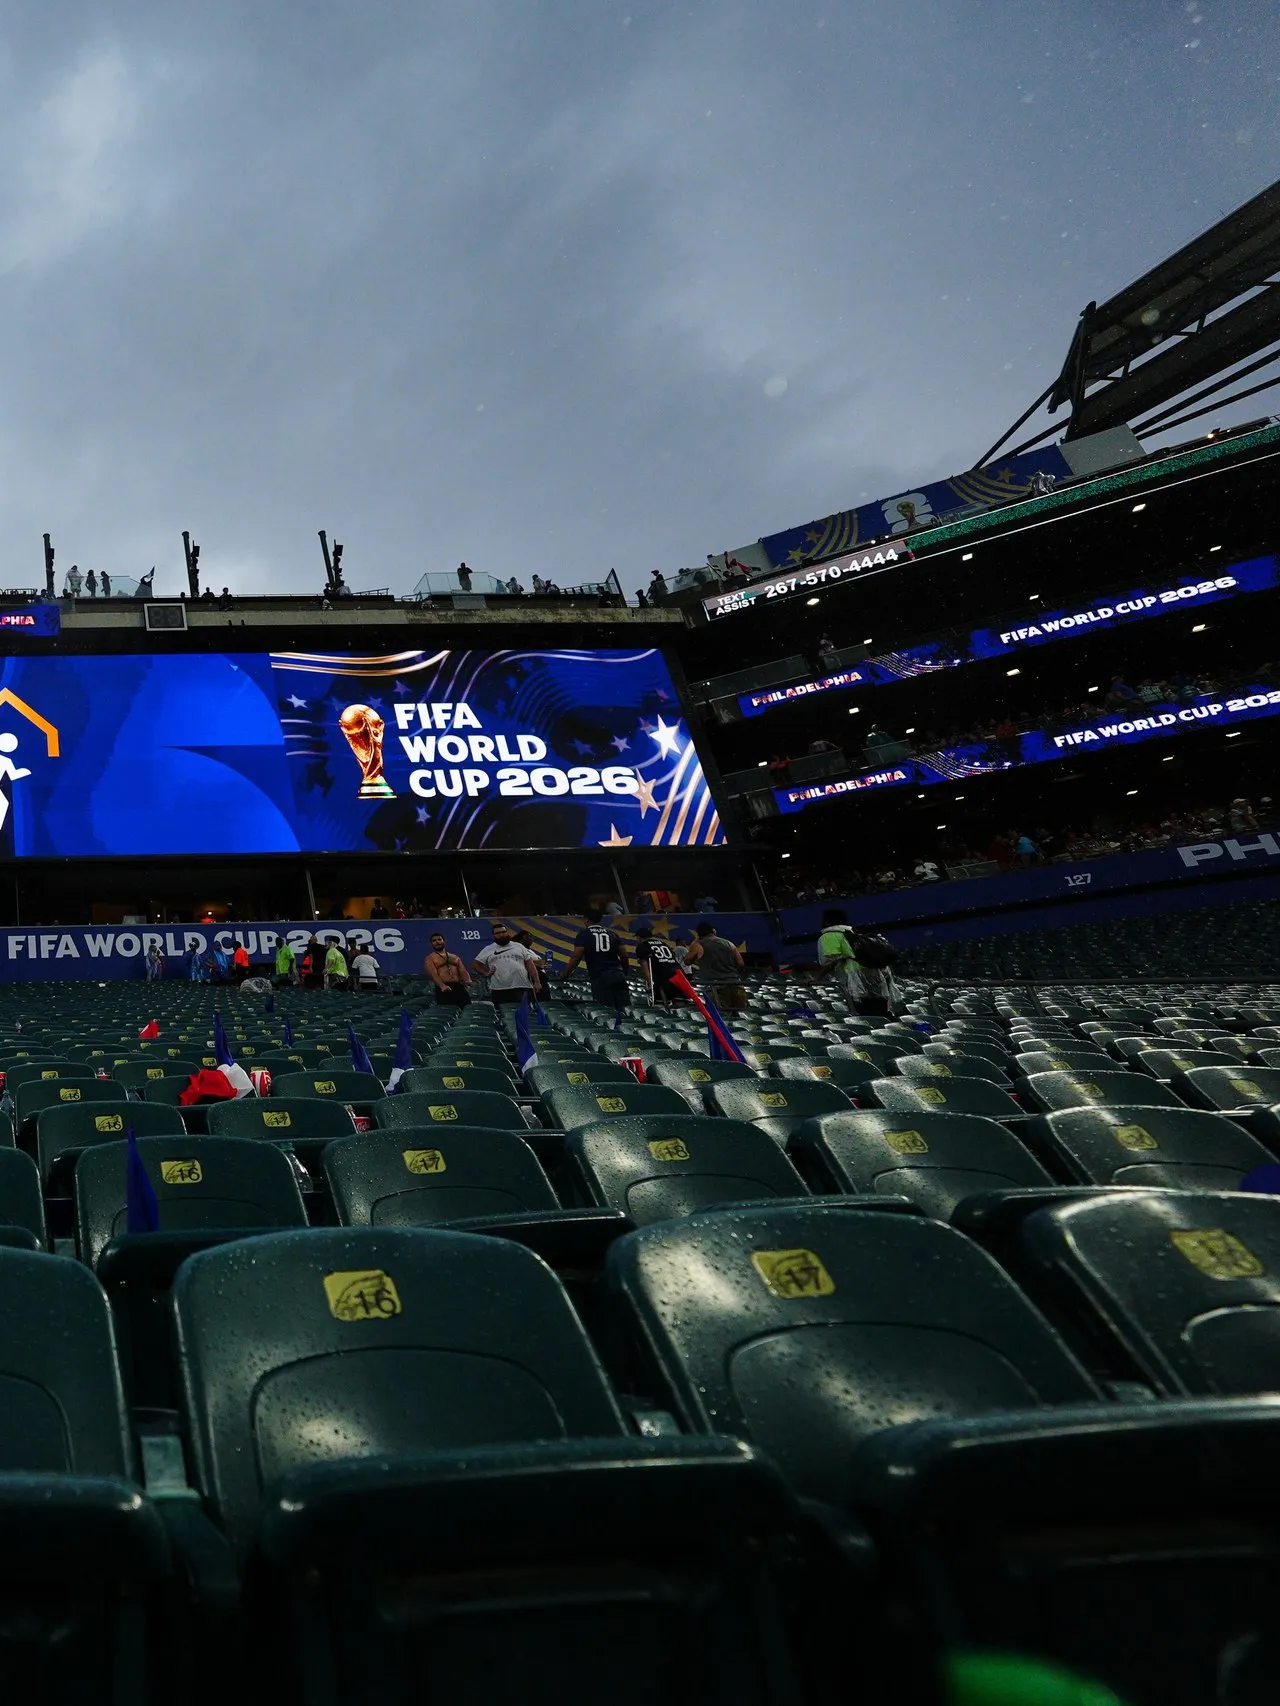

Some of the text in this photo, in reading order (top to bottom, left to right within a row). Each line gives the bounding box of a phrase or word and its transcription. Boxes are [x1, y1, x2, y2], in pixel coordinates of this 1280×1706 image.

[716, 548, 899, 616] ASSIST 267-570-4444
[717, 591, 746, 606] TEXT
[1000, 576, 1237, 644] FIFA WORLD CUP 2026
[751, 671, 863, 706] PHILADELPHIA
[393, 702, 483, 730] FIFA
[1053, 730, 1100, 748] FIFA
[1097, 713, 1177, 738] WORLD
[1179, 703, 1224, 722] CUP
[398, 734, 547, 763] WORLD
[408, 766, 639, 797] CUP 2026
[788, 770, 907, 803] PHILADELPHIA
[1176, 831, 1280, 868] PH
[1064, 873, 1092, 887] 127
[7, 934, 81, 959] FIFA
[84, 931, 208, 958] WORLD
[213, 929, 279, 956] CUP
[461, 930, 481, 940] 128
[592, 932, 610, 953] 10
[651, 945, 673, 959] 30
[106, 1119, 121, 1130] 16
[274, 1116, 288, 1126] 17
[440, 1109, 457, 1119] 18
[419, 1156, 440, 1171] 17
[665, 1144, 690, 1159] 18
[177, 1166, 200, 1182] 16
[784, 1265, 822, 1292] 17
[355, 1286, 397, 1316] 16
